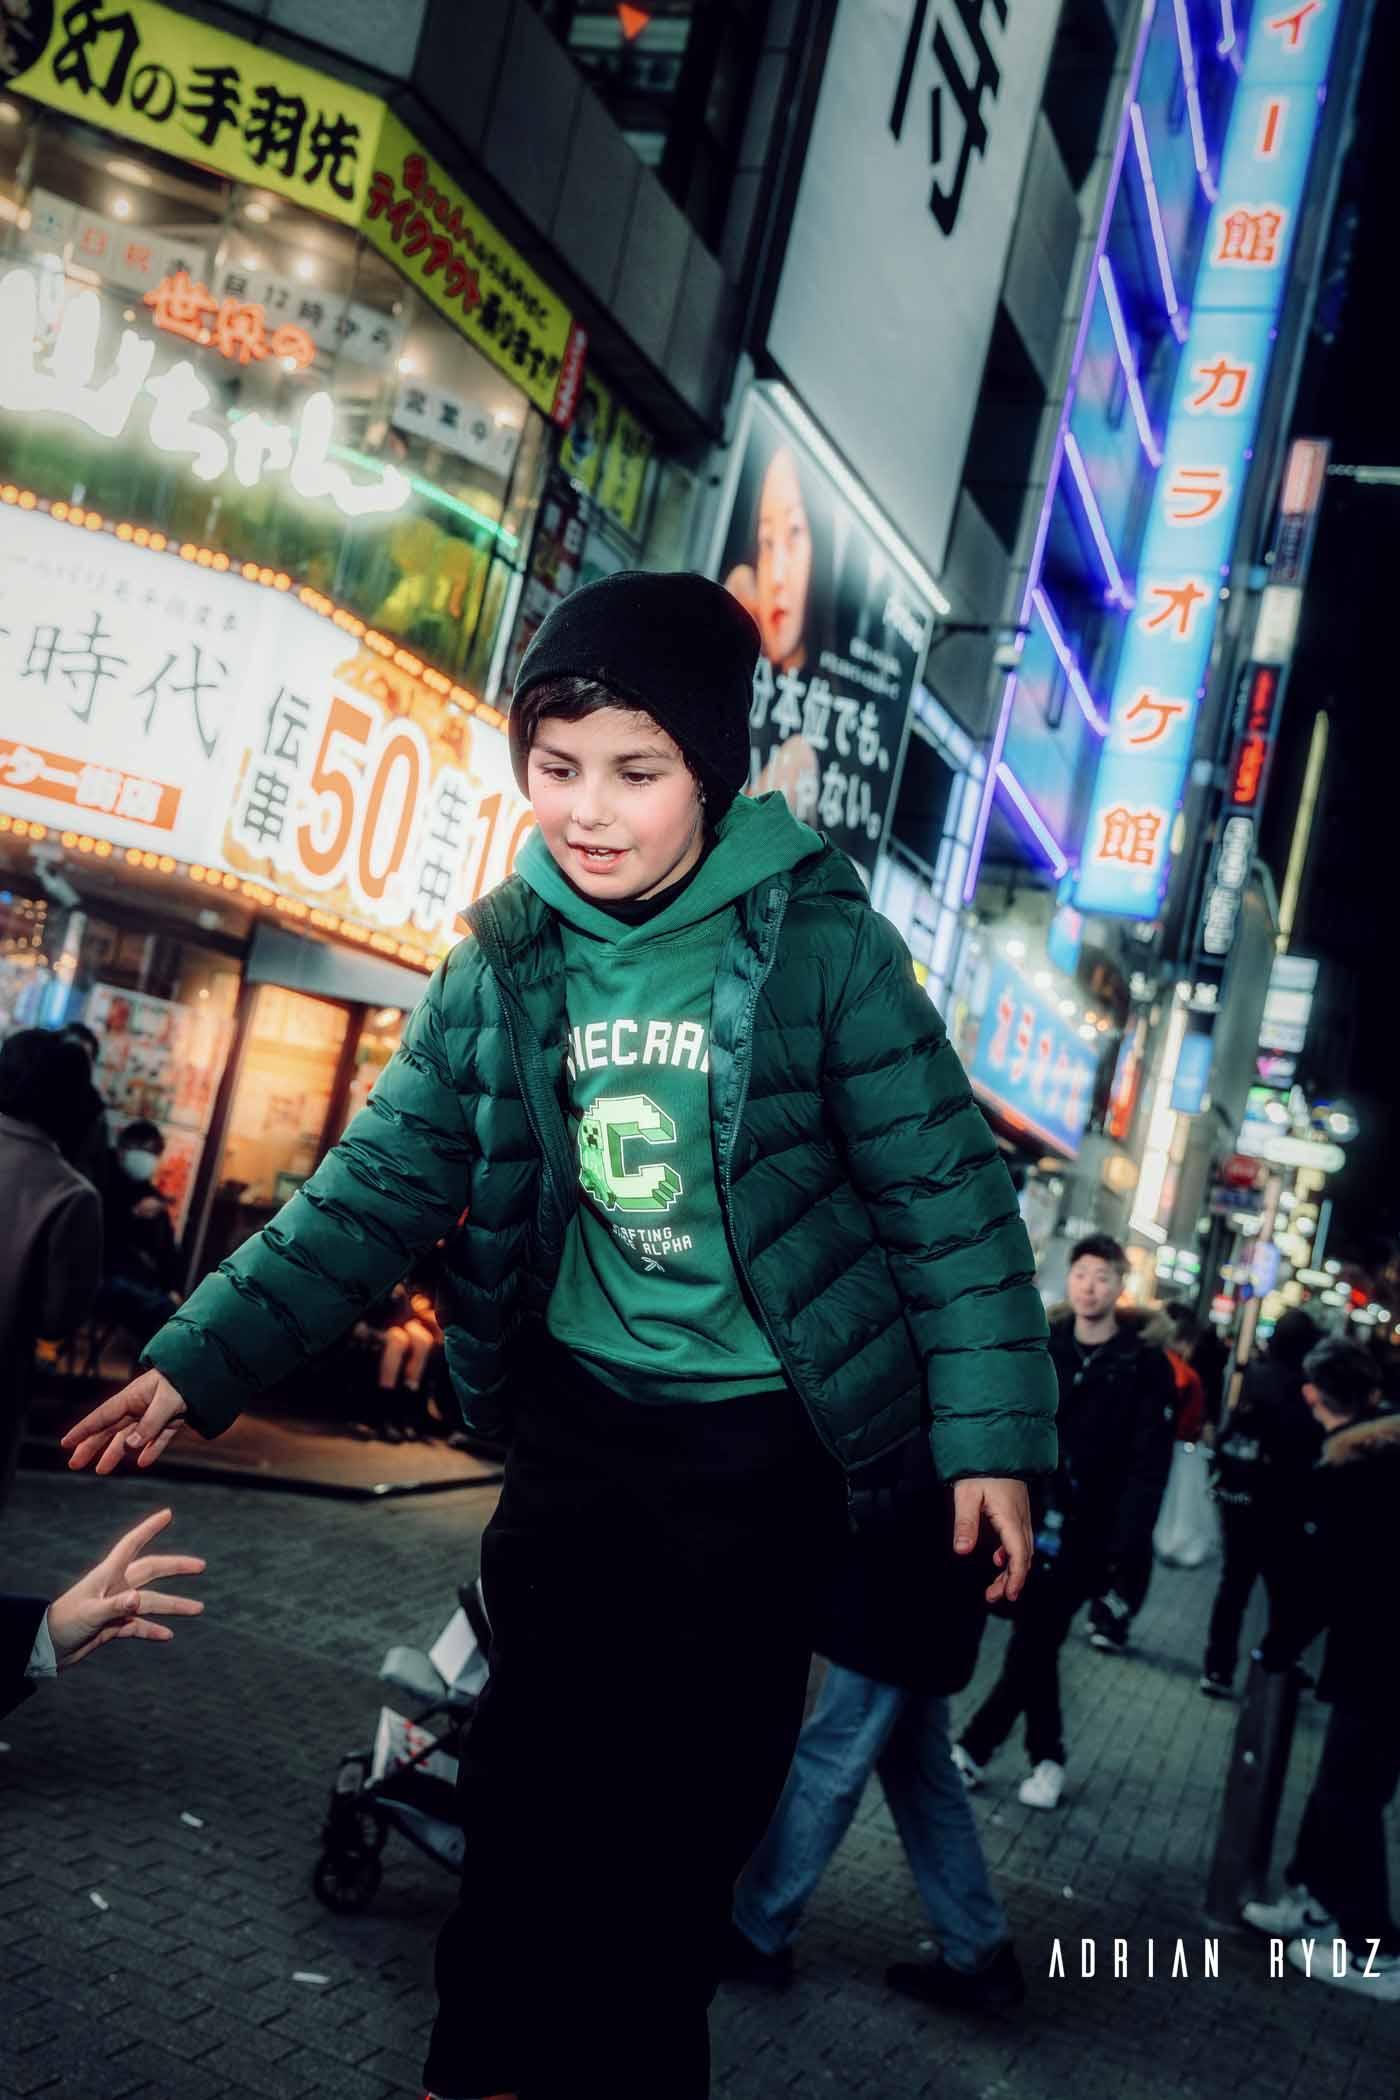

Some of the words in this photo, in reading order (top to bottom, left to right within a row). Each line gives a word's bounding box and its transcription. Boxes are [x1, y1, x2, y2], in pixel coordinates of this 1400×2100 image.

[52, 0, 363, 201] 幻の手羽先
[145, 271, 317, 367] 世界の
[0, 611, 228, 759] 時代
[296, 695, 421, 900] 50
[642, 1234, 693, 1256] ALPHA
